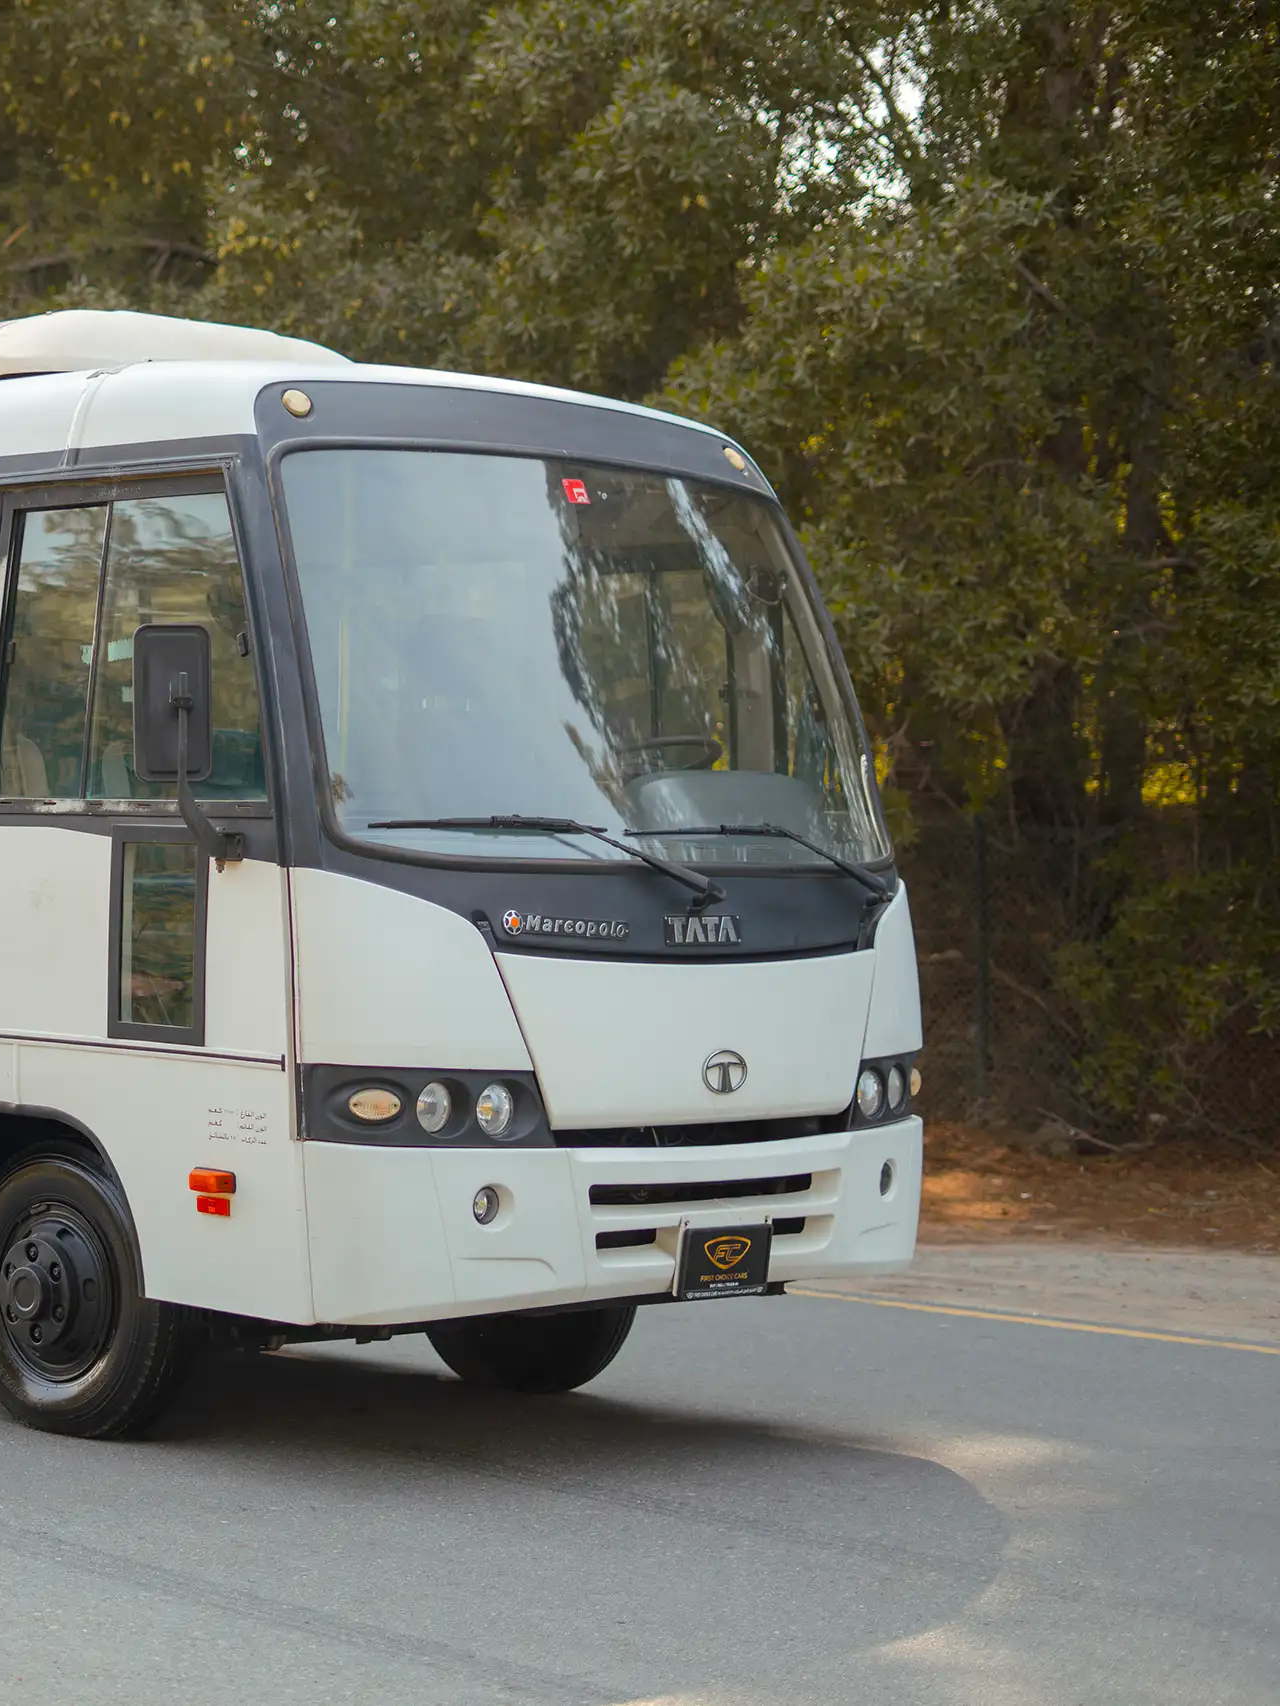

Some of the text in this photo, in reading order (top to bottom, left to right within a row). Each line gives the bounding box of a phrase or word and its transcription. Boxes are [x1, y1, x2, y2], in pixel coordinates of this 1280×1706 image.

[525, 914, 626, 938] Marcopolo
[668, 916, 738, 943] TATA
[700, 1272, 748, 1282] FIRST CHOICE CARS
